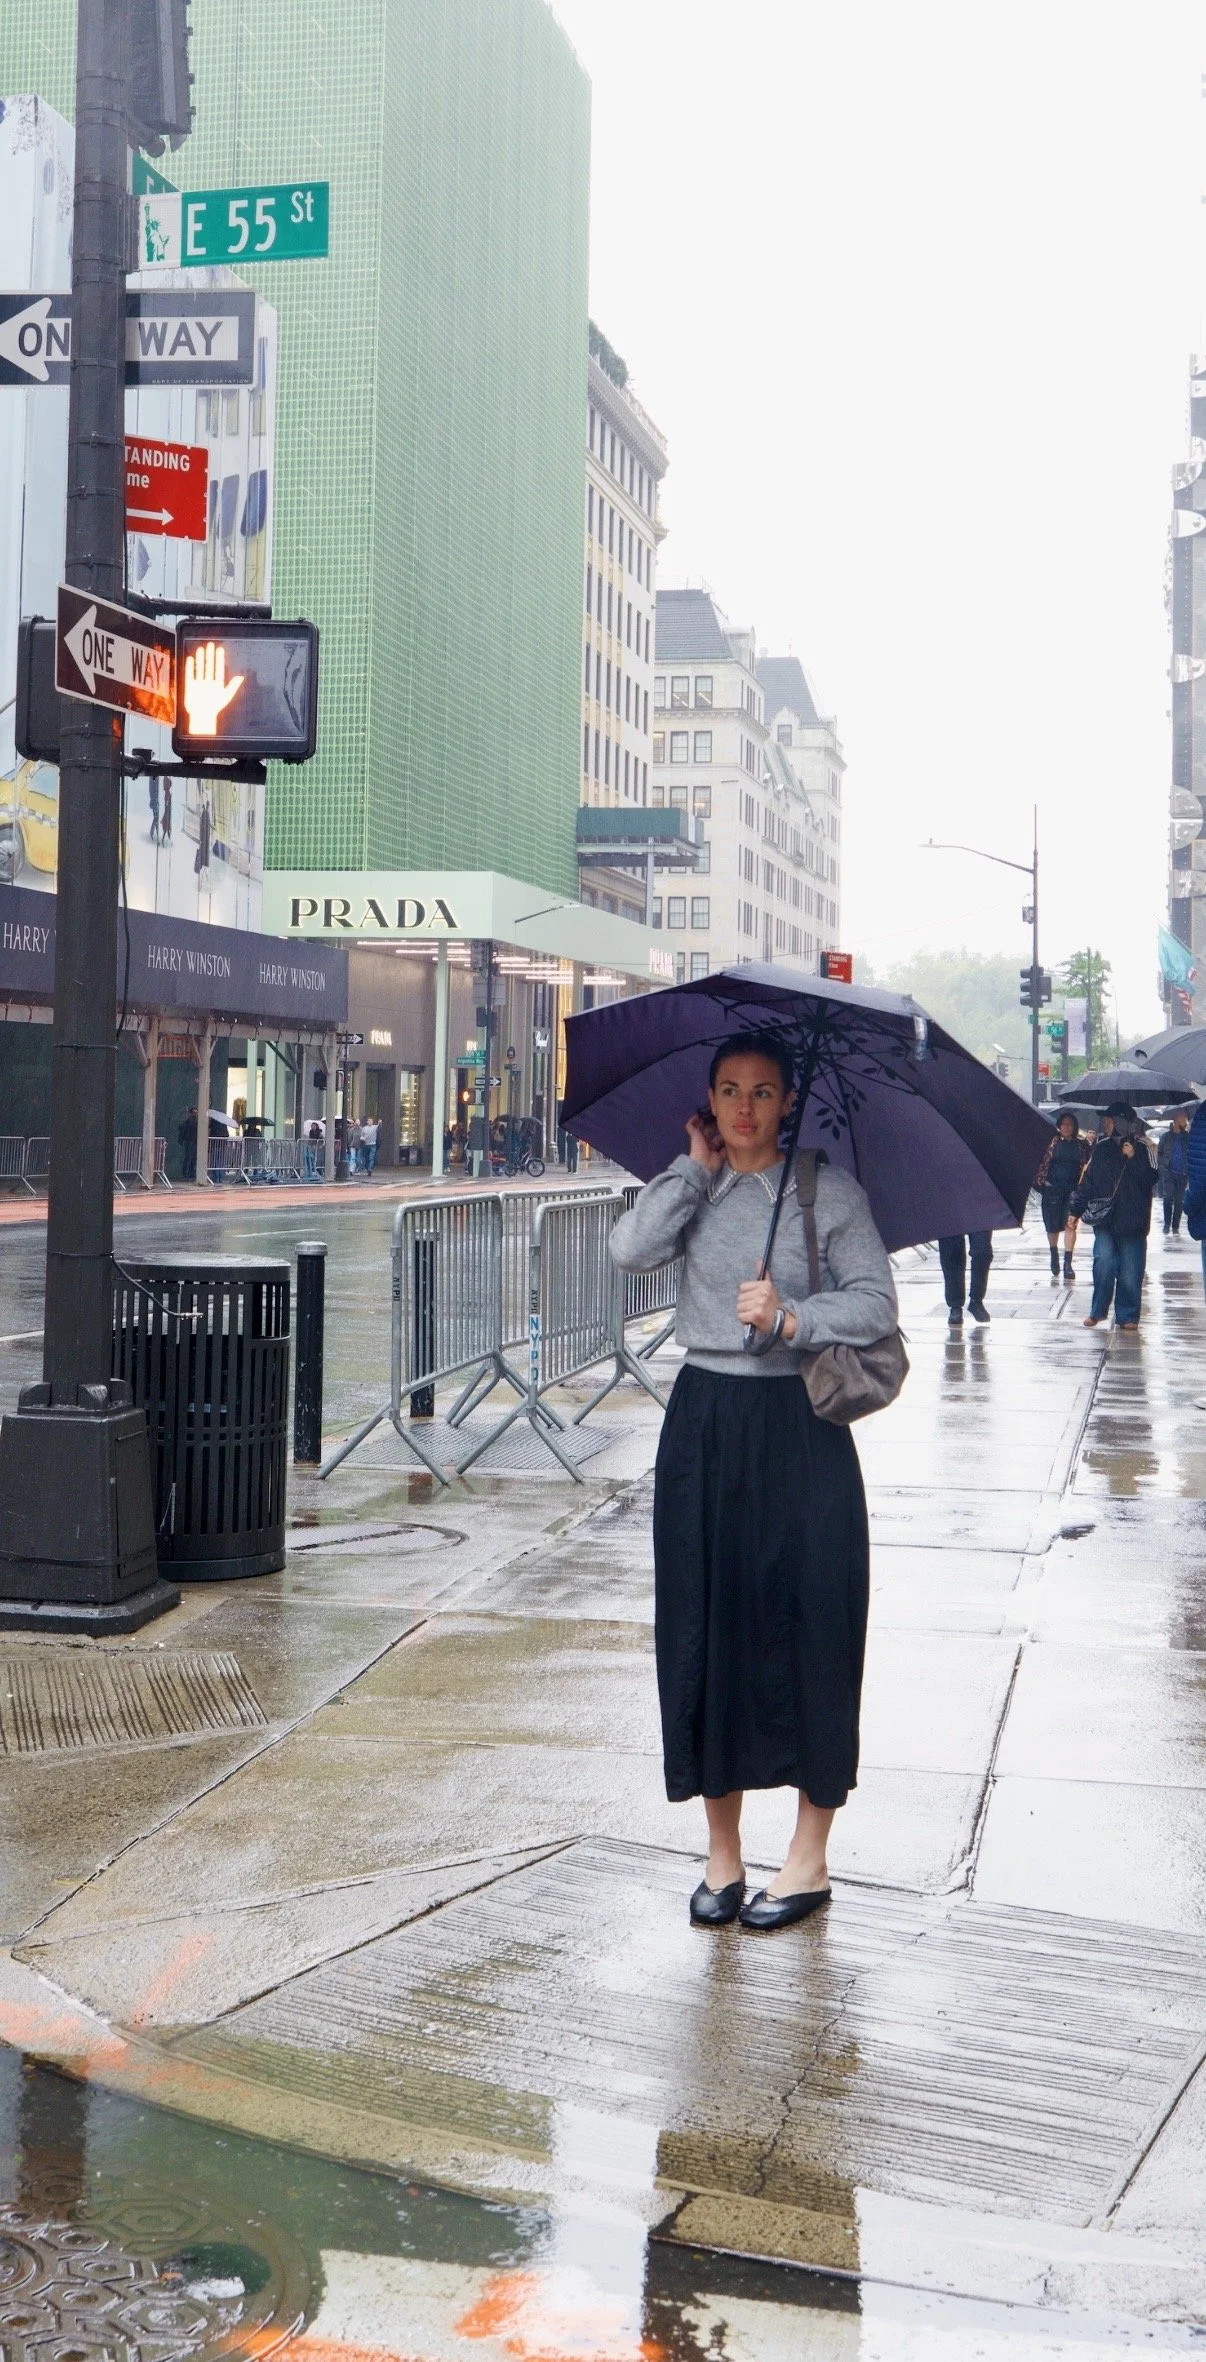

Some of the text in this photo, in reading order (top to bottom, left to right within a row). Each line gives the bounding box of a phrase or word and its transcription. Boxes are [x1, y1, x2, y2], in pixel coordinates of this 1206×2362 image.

[186, 190, 315, 256] E 55 St
[18, 321, 223, 357] ON WAY
[124, 445, 190, 472] TANDING
[82, 628, 164, 690] ONE WAY
[290, 898, 459, 928] PRADA
[3, 922, 50, 954] HARRY
[147, 945, 231, 978] HARRY WINSTON
[259, 963, 326, 991] HARRY WINSTON
[530, 1316, 539, 1381] NYPD
